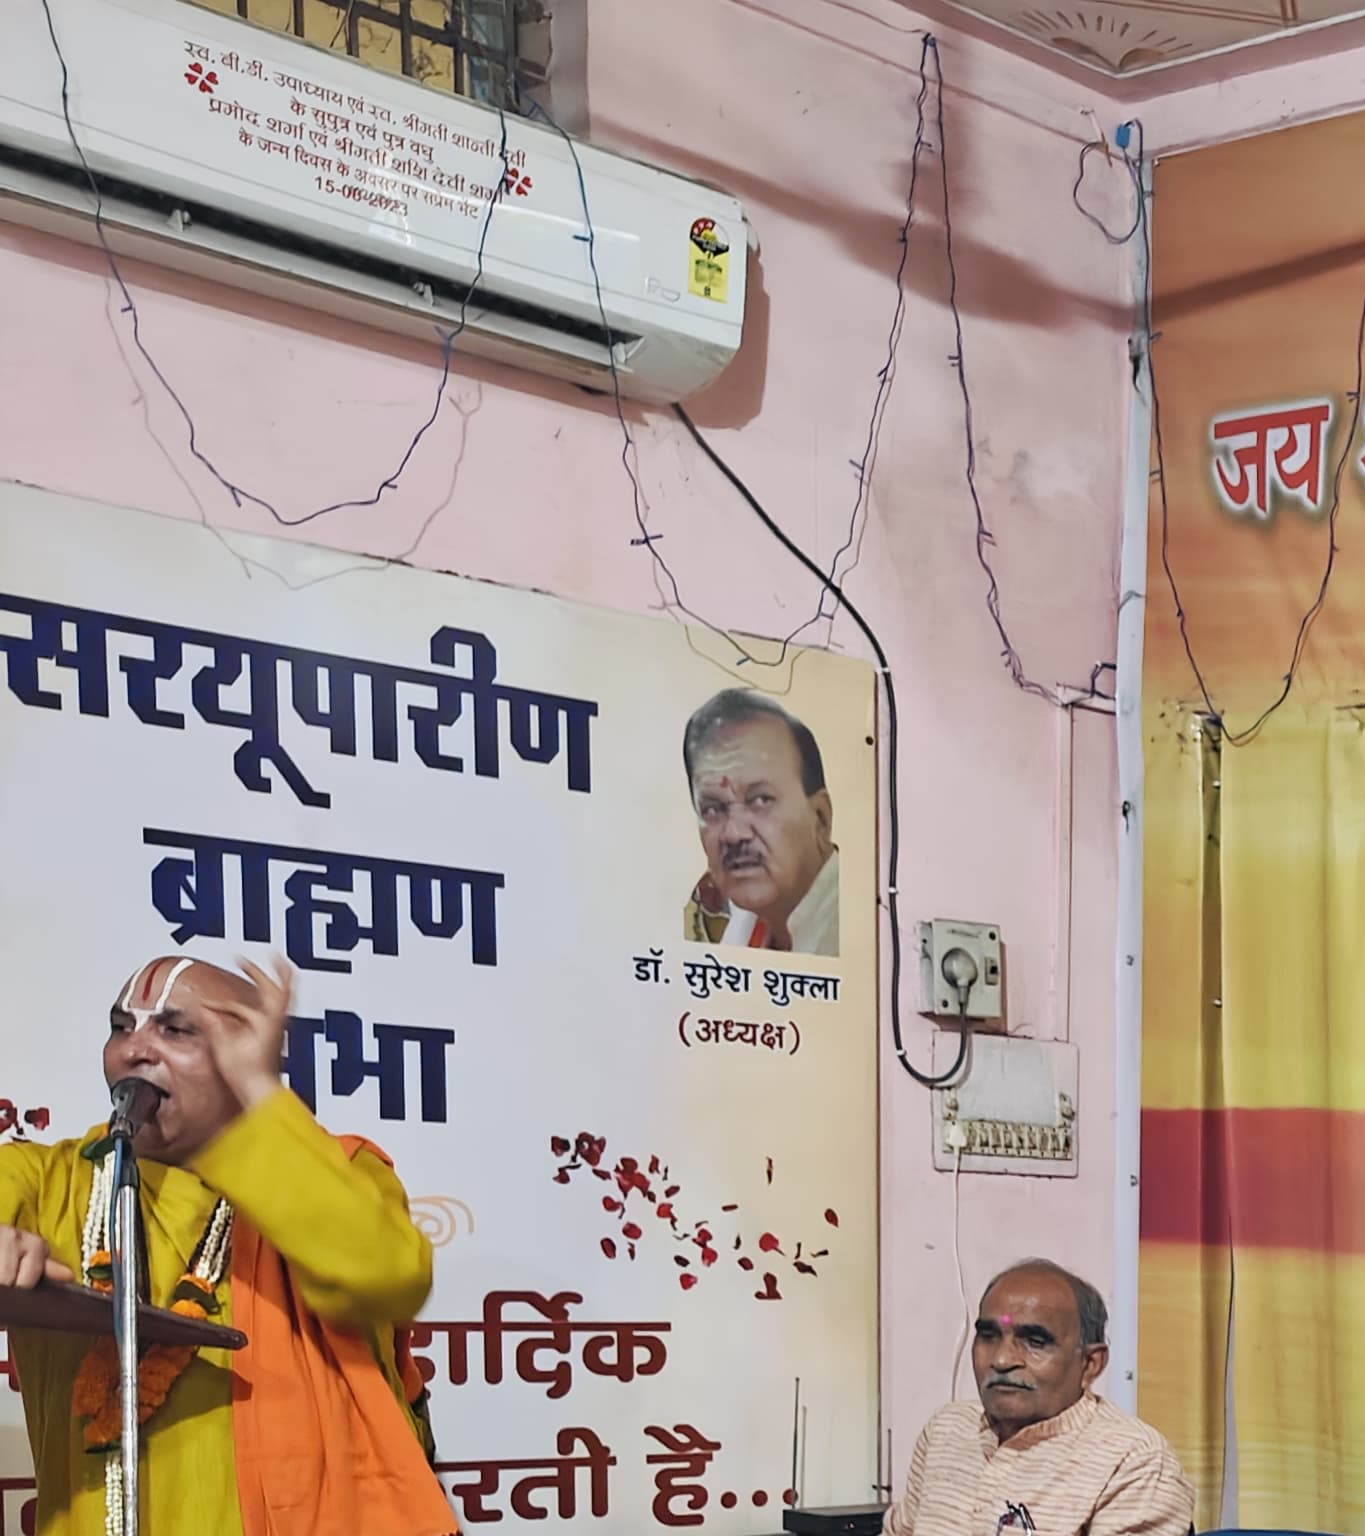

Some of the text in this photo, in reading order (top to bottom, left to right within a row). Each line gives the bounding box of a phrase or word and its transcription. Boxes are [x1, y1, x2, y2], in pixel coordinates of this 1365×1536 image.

[289, 96, 306, 117] के
[311, 106, 351, 134] सुपुत्र
[355, 124, 377, 141] एवं
[347, 95, 365, 114] एवं
[239, 126, 254, 146] के
[257, 136, 291, 160] जन्म
[336, 158, 351, 178] के
[265, 117, 307, 141] शर्मा
[308, 129, 329, 149] एवं
[1215, 405, 1330, 513] जय
[0, 594, 599, 809] सरयूपारीण
[142, 826, 505, 974] ब्राह्मण
[633, 947, 841, 1007] डॉ. सुरेश शुक्ला
[678, 1011, 801, 1056] (अध्यक्ष)
